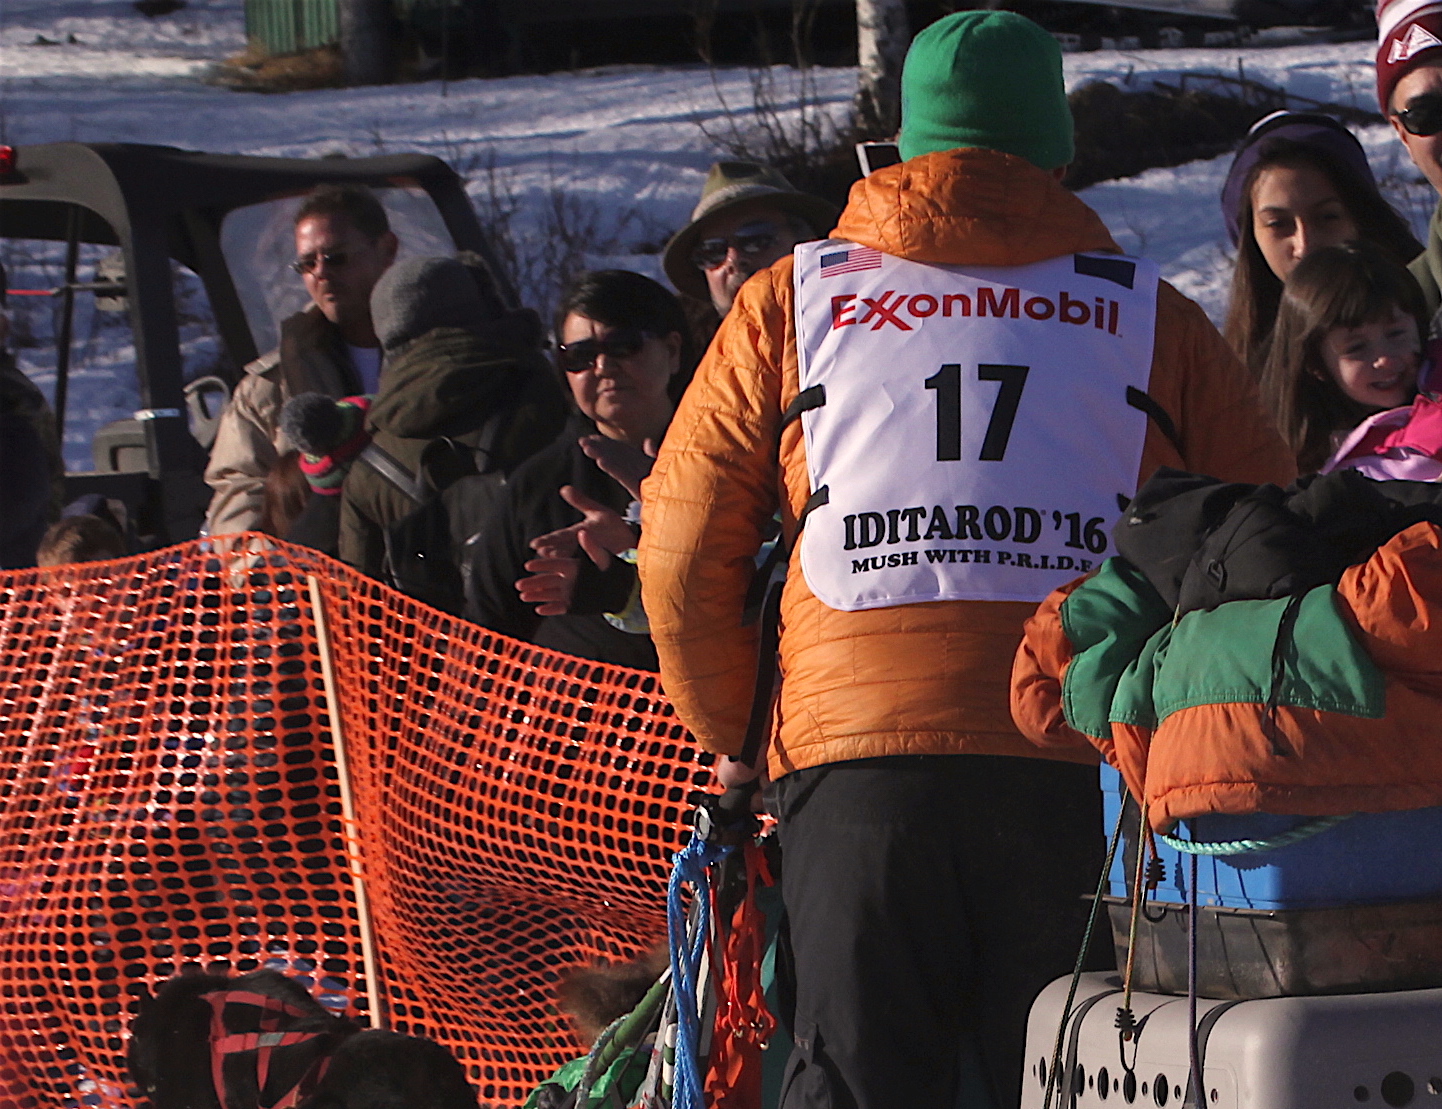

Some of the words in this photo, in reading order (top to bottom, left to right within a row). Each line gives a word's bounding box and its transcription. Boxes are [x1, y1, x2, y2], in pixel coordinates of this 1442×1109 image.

[924, 363, 1031, 462] 17
[842, 504, 1043, 551] IDITAROD
[1052, 510, 1108, 554] '16
[851, 551, 919, 574] MUSH
[924, 549, 992, 564] WITH
